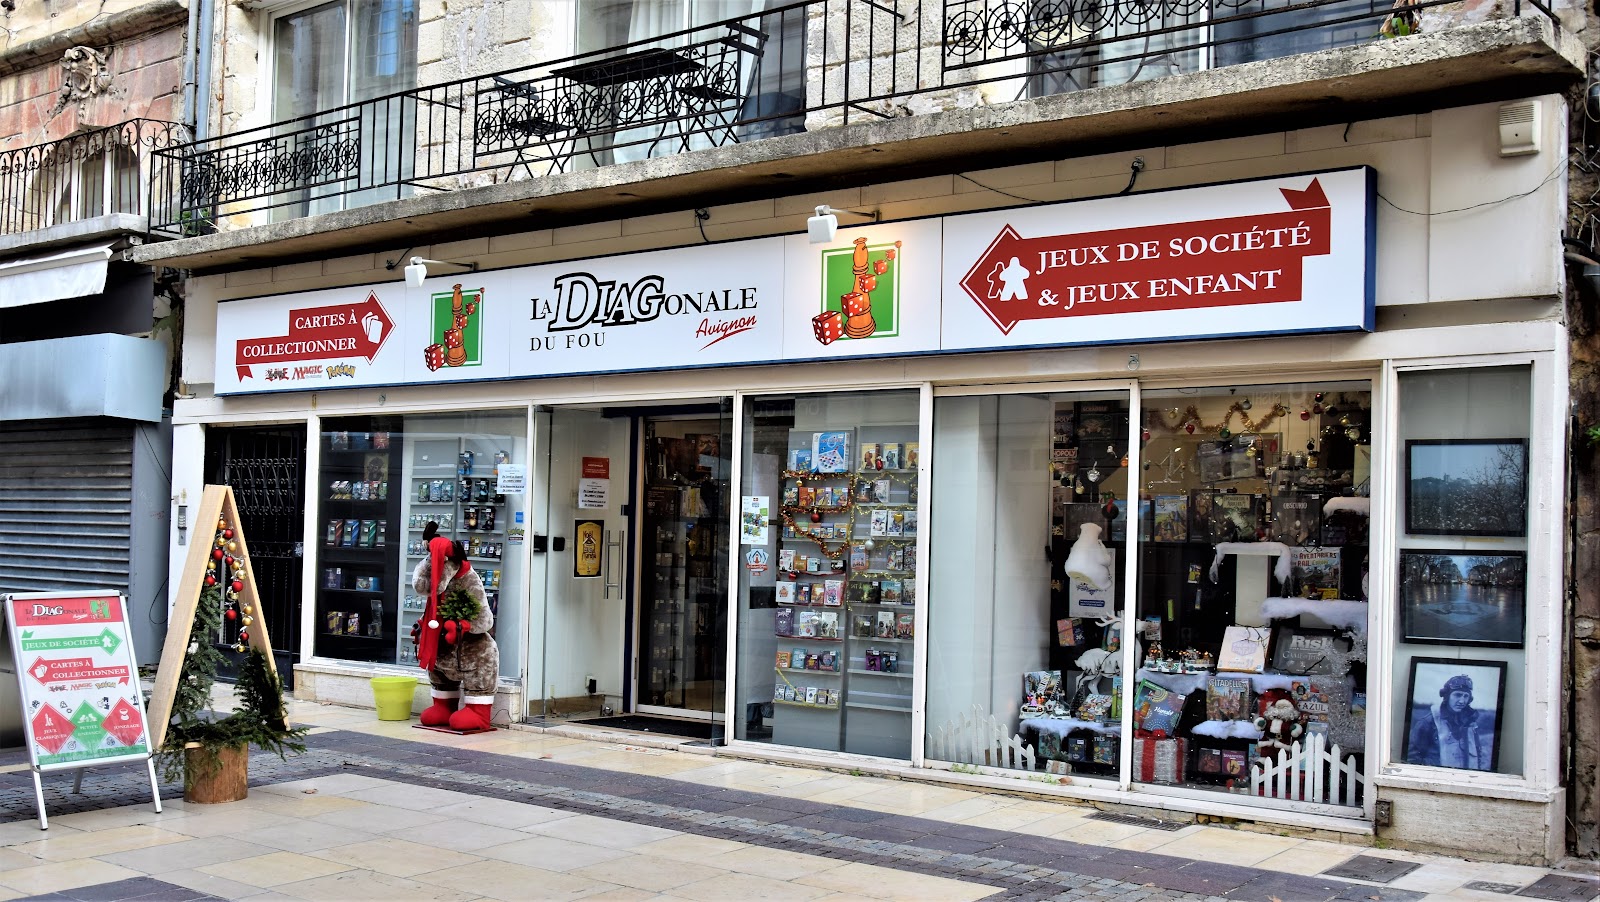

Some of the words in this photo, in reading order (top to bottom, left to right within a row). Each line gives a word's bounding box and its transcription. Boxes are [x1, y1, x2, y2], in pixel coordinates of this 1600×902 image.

[1036, 245, 1109, 275] JEUX
[1117, 240, 1160, 262] DE
[1169, 221, 1311, 258] SOCIÉTÉ
[1037, 289, 1059, 306] &
[1064, 281, 1139, 309] JEUX
[1147, 268, 1282, 299] ENFANT
[530, 298, 552, 320] LA
[548, 272, 758, 332] DIAGONALE
[295, 312, 345, 330] CARTES
[347, 309, 357, 325] À
[695, 315, 757, 339] Avignon
[243, 337, 357, 358] COLLECTIONNER
[529, 335, 556, 351] DU
[565, 332, 606, 349] FOU
[292, 365, 324, 380] MAGIC
[25, 642, 47, 650] JEUX
[63, 638, 100, 647] SOCIÉTÉ
[50, 661, 83, 669] CARTES
[52, 668, 126, 679] COLLECTIONNER
[1302, 702, 1326, 712] AZUL
